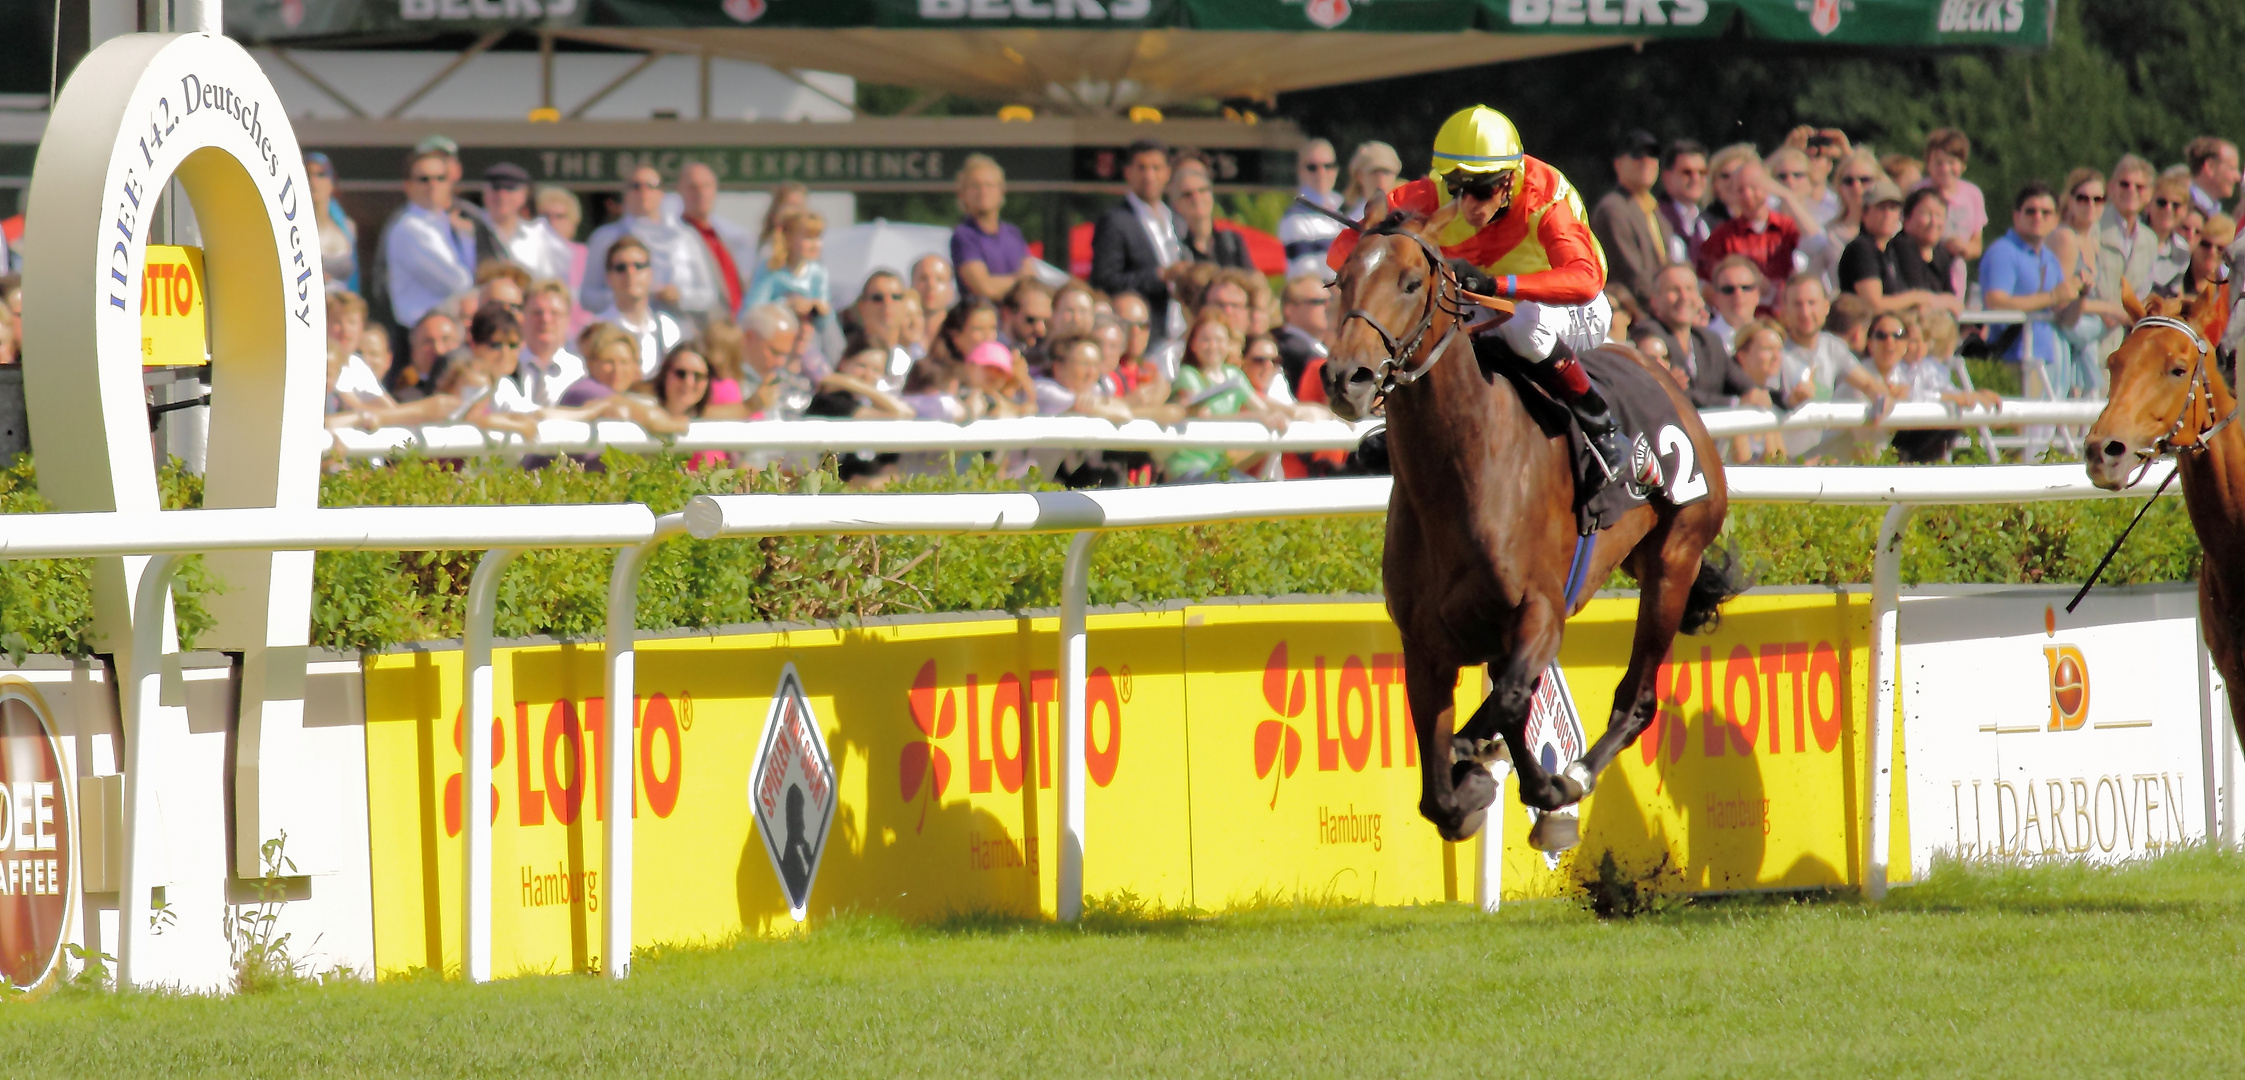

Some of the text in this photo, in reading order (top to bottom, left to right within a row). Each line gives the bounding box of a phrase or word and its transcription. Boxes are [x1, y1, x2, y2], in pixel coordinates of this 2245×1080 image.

[540, 151, 602, 178] THE
[739, 151, 944, 178] EXPERIENCE
[110, 73, 312, 328] IDEE 142. Deutsches Derby
[1658, 424, 1709, 505] 2
[1553, 701, 1578, 764] SUCHT
[760, 725, 792, 819] SPIELEN
[801, 740, 828, 812] SUCHT
[1318, 803, 1382, 852] Hamburg
[1705, 788, 1771, 836] Hamburg
[969, 826, 1040, 877] Hamburg
[521, 861, 598, 913] Hamburg
